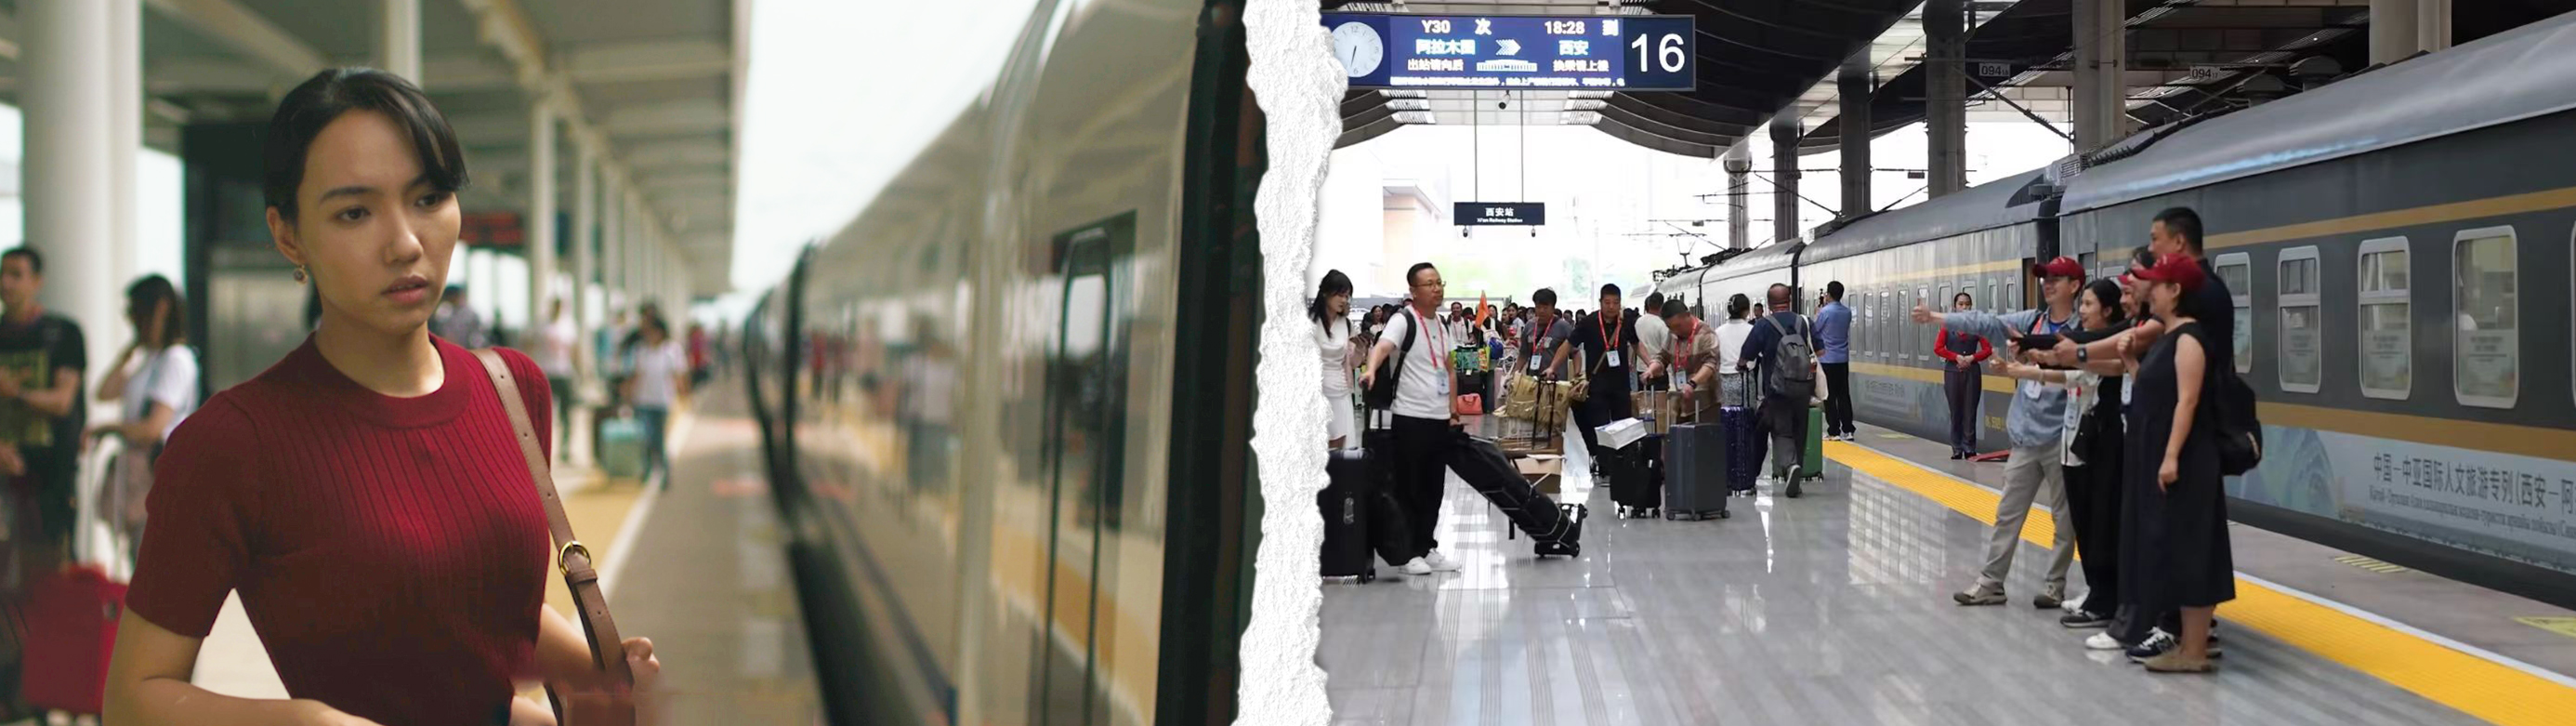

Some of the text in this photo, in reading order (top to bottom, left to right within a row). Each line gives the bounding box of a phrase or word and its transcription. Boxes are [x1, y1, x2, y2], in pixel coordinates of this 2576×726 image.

[1422, 20, 1451, 33] Y30
[1475, 18, 1492, 35] 次
[1544, 20, 1585, 34] 18:28
[1631, 33, 1685, 73] 16
[1485, 207, 1515, 217] 西安站
